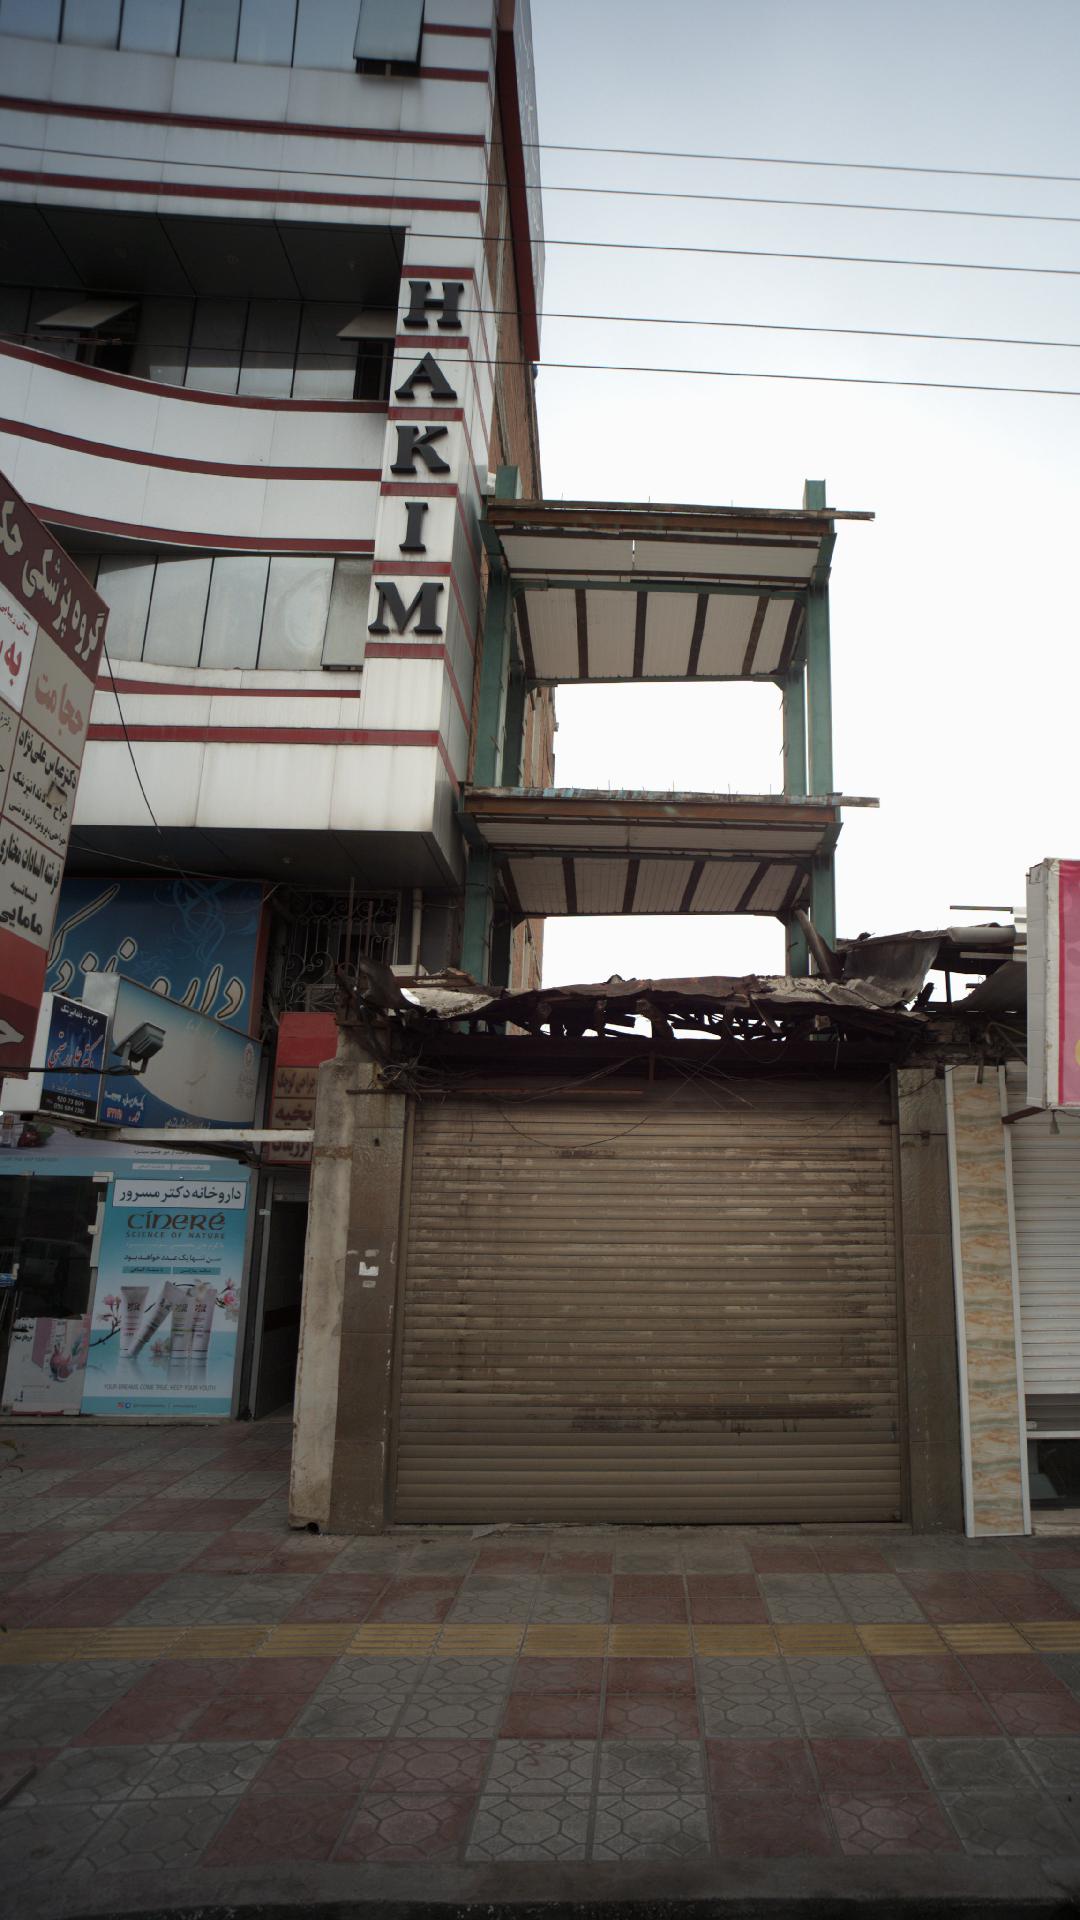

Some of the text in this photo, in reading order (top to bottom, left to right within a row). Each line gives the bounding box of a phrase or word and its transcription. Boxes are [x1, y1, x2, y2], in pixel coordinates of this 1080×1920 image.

[368, 280, 466, 635] HAKIM
[22, 549, 72, 638] پزشکی
[71, 600, 105, 662] گروه
[34, 672, 84, 736] حجامت
[45, 756, 64, 780] عباس
[61, 768, 77, 790] دکتر
[13, 771, 48, 804] دندانپزشک
[53, 805, 68, 826] جراح
[0, 904, 43, 936] مامایی
[119, 1185, 241, 1204] داروخانه دکتر مسرور
[126, 1231, 164, 1239] SCIENCE
